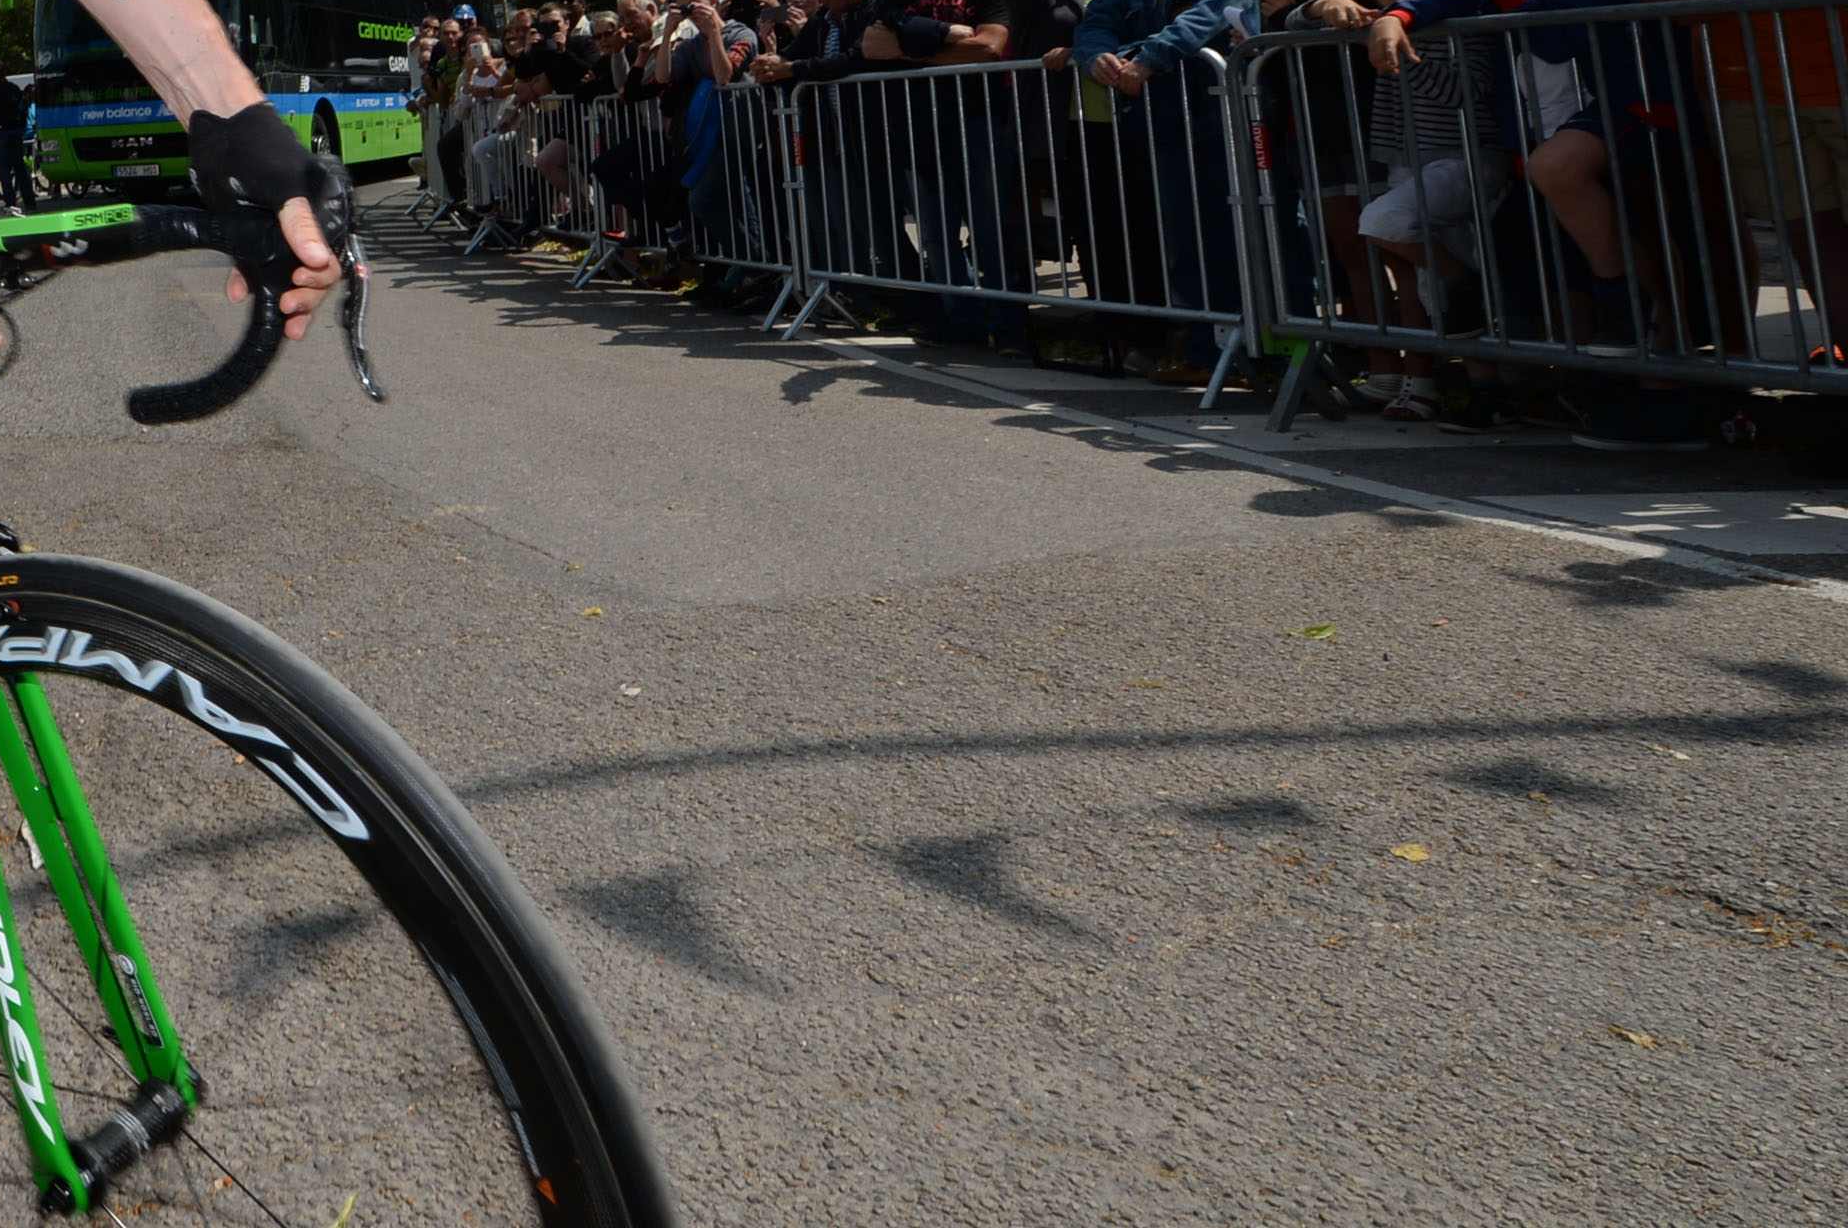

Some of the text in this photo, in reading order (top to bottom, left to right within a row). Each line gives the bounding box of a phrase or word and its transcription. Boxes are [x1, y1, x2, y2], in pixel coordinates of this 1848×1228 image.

[358, 21, 413, 43] cannondale
[389, 55, 409, 72] GARM
[82, 110, 105, 121] new
[106, 105, 152, 118] balance
[74, 212, 103, 227] SRM
